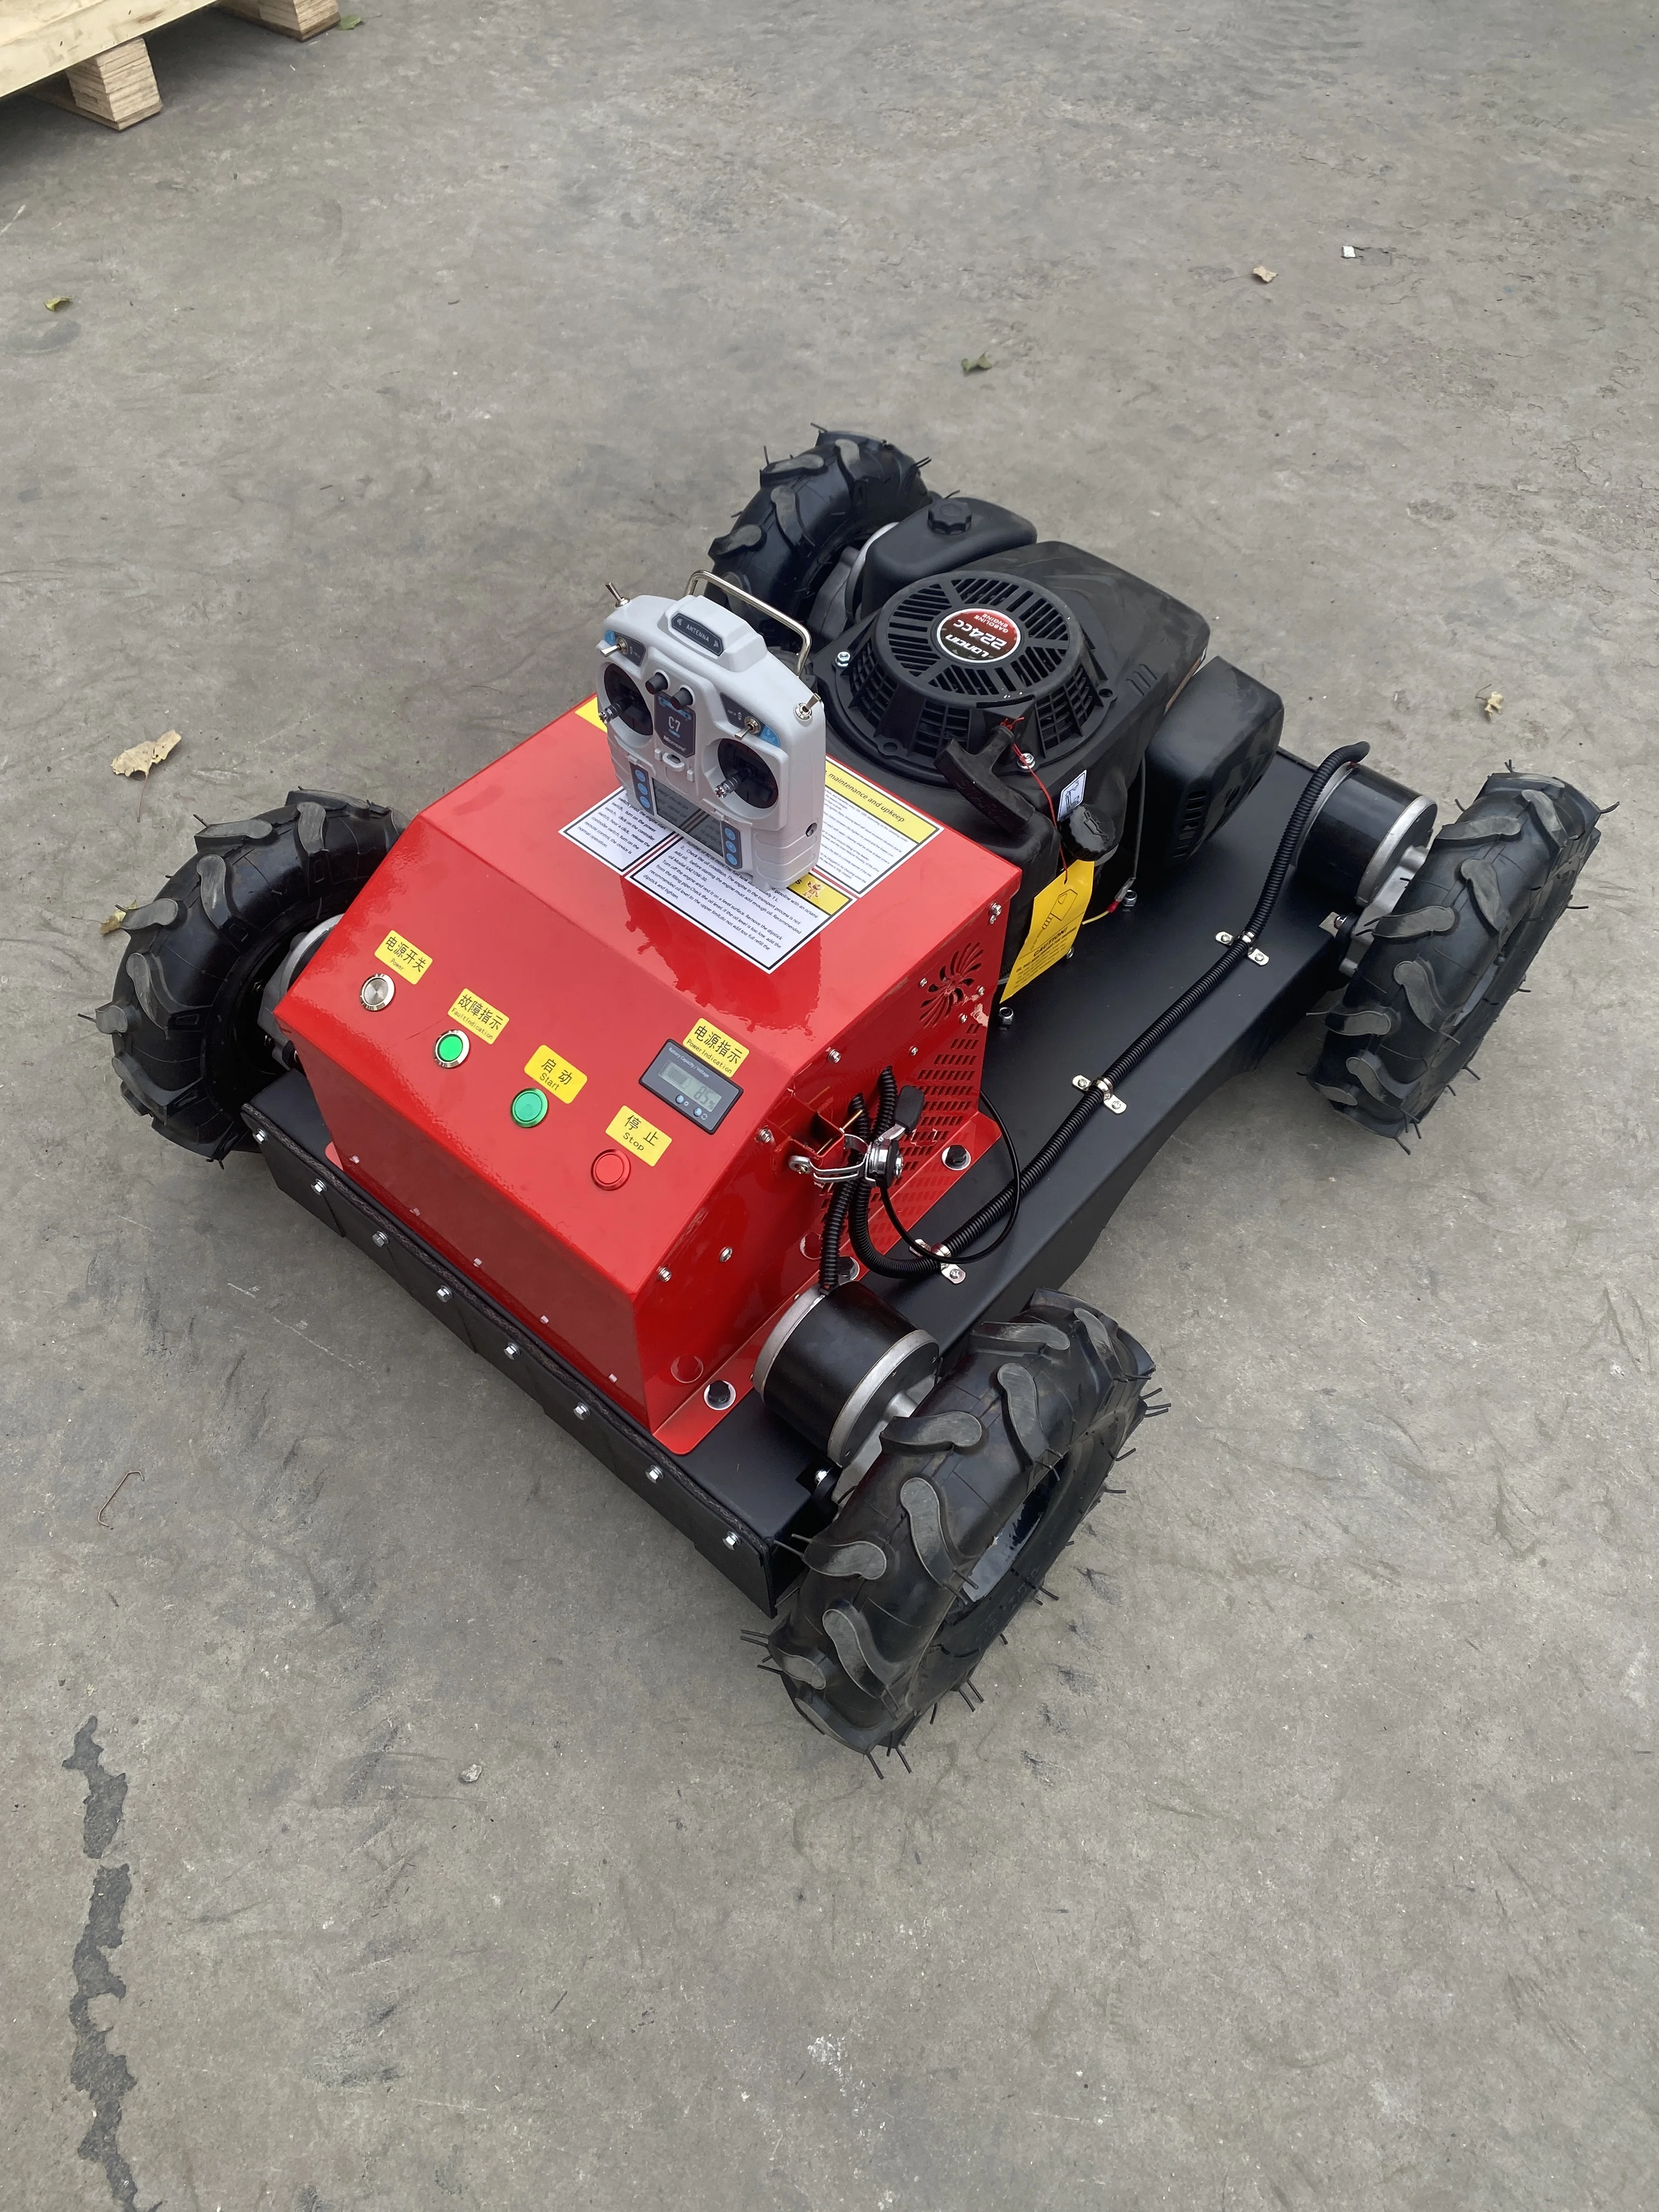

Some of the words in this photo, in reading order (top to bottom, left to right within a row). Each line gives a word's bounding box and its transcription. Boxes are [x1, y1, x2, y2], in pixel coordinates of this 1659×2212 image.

[974, 614, 1008, 633] GASOLINE
[982, 613, 1008, 627] ENGINE
[686, 624, 709, 642] ANTENNA
[669, 716, 680, 732] C7
[828, 774, 868, 799] maintenance
[867, 798, 882, 807] and
[881, 806, 904, 822] upkeep
[591, 817, 608, 828] controller
[643, 823, 656, 832] power
[645, 815, 659, 824] engine
[578, 826, 591, 836] normal
[584, 821, 597, 831] remote
[617, 843, 628, 851] device
[631, 834, 644, 843] release
[637, 829, 655, 840] controller
[673, 858, 686, 867] Model
[643, 874, 657, 884] dipstick
[650, 870, 676, 888] recommended
[672, 874, 682, 883] filling
[686, 849, 698, 857] Check
[734, 881, 747, 890] engine
[758, 896, 775, 908] transport
[774, 907, 789, 917] process
[689, 860, 702, 869] before
[701, 868, 715, 879] starting
[722, 882, 735, 891] engine
[752, 901, 766, 912] enough
[772, 915, 802, 934] Recommended
[774, 888, 791, 900] gasoline
[804, 909, 818, 918] octane
[682, 874, 696, 883] engine
[731, 905, 744, 916] surface.
[745, 914, 760, 926] Remove
[767, 929, 782, 940] dipstick
[1034, 927, 1068, 957] CAUTION!
[385, 936, 426, 972] 电源开关
[390, 958, 404, 971] Power
[458, 994, 504, 1030] 故障指示
[694, 1025, 742, 1064] 电源指示
[541, 1058, 572, 1085] 启动
[668, 1047, 680, 1058] Battery
[680, 1055, 695, 1068] Capacity
[696, 1066, 709, 1078] Voltage
[540, 1073, 560, 1091] Start
[624, 1115, 658, 1146] 停止
[623, 1132, 644, 1150] Stop
